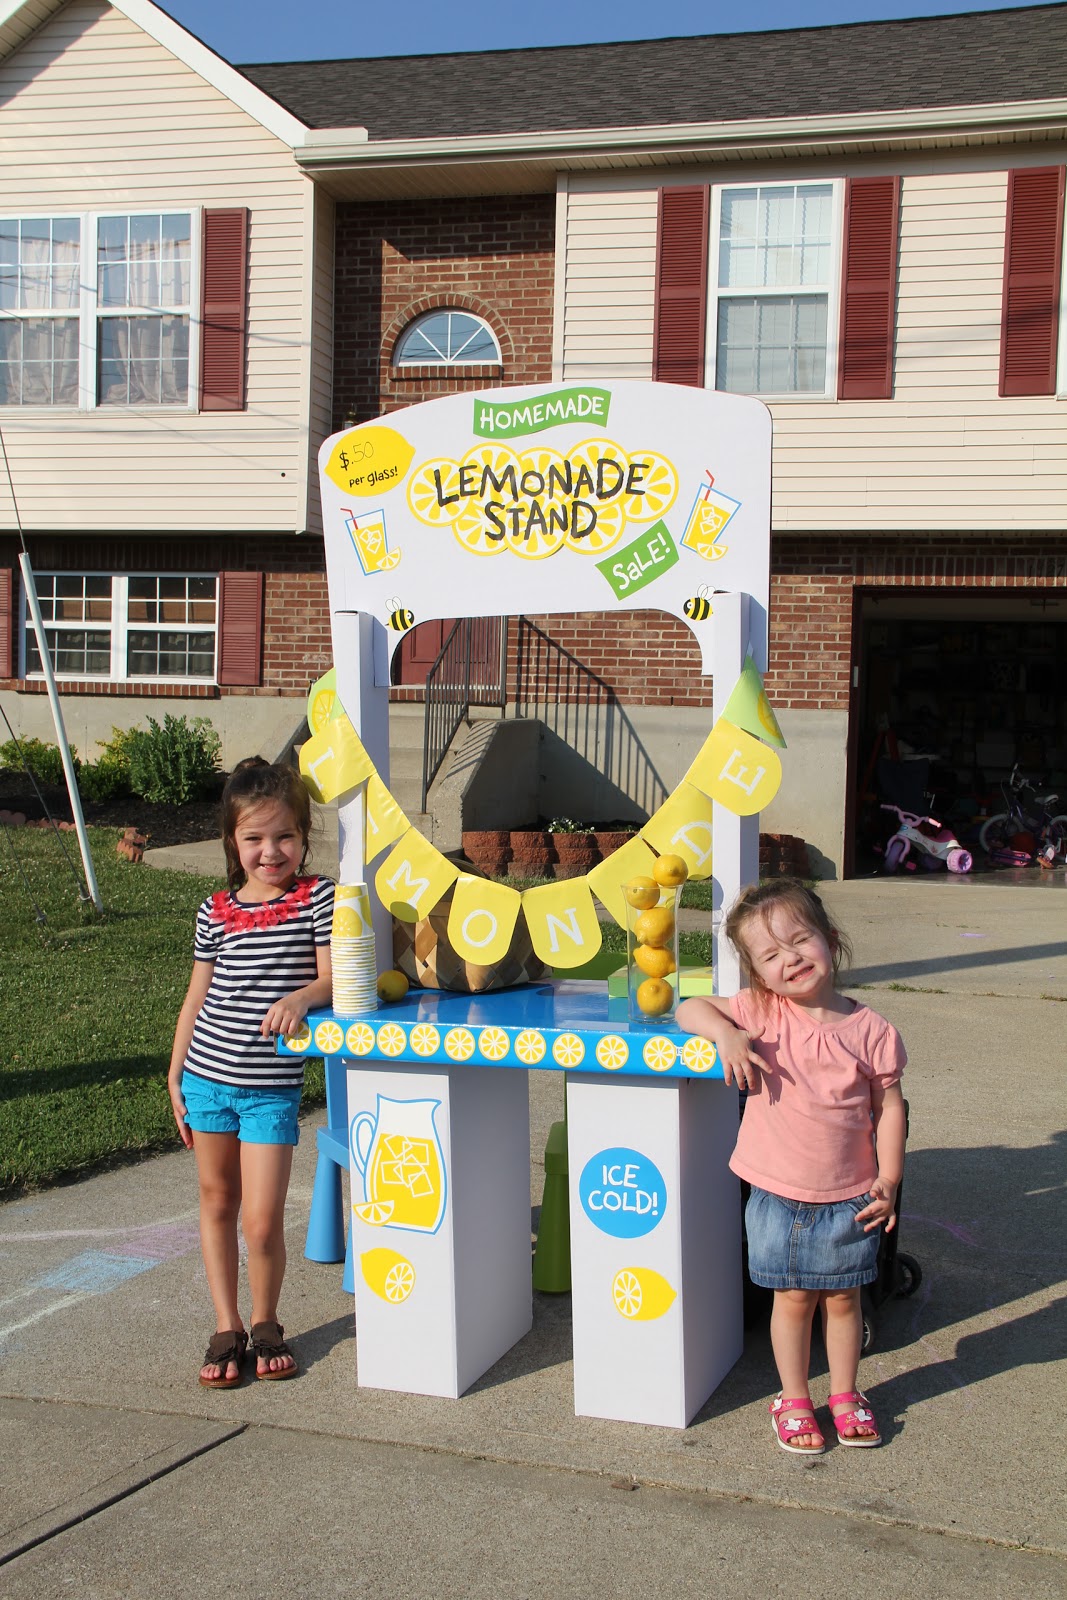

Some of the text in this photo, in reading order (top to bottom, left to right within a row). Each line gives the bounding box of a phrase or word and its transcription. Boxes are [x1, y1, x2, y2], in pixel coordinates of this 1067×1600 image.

[480, 394, 605, 431] HOMEMADE
[349, 476, 365, 488] per
[433, 458, 650, 507] LEMONADE
[484, 500, 598, 541] STAND
[602, 1163, 640, 1188] ICE
[588, 1189, 659, 1216] COLD!
